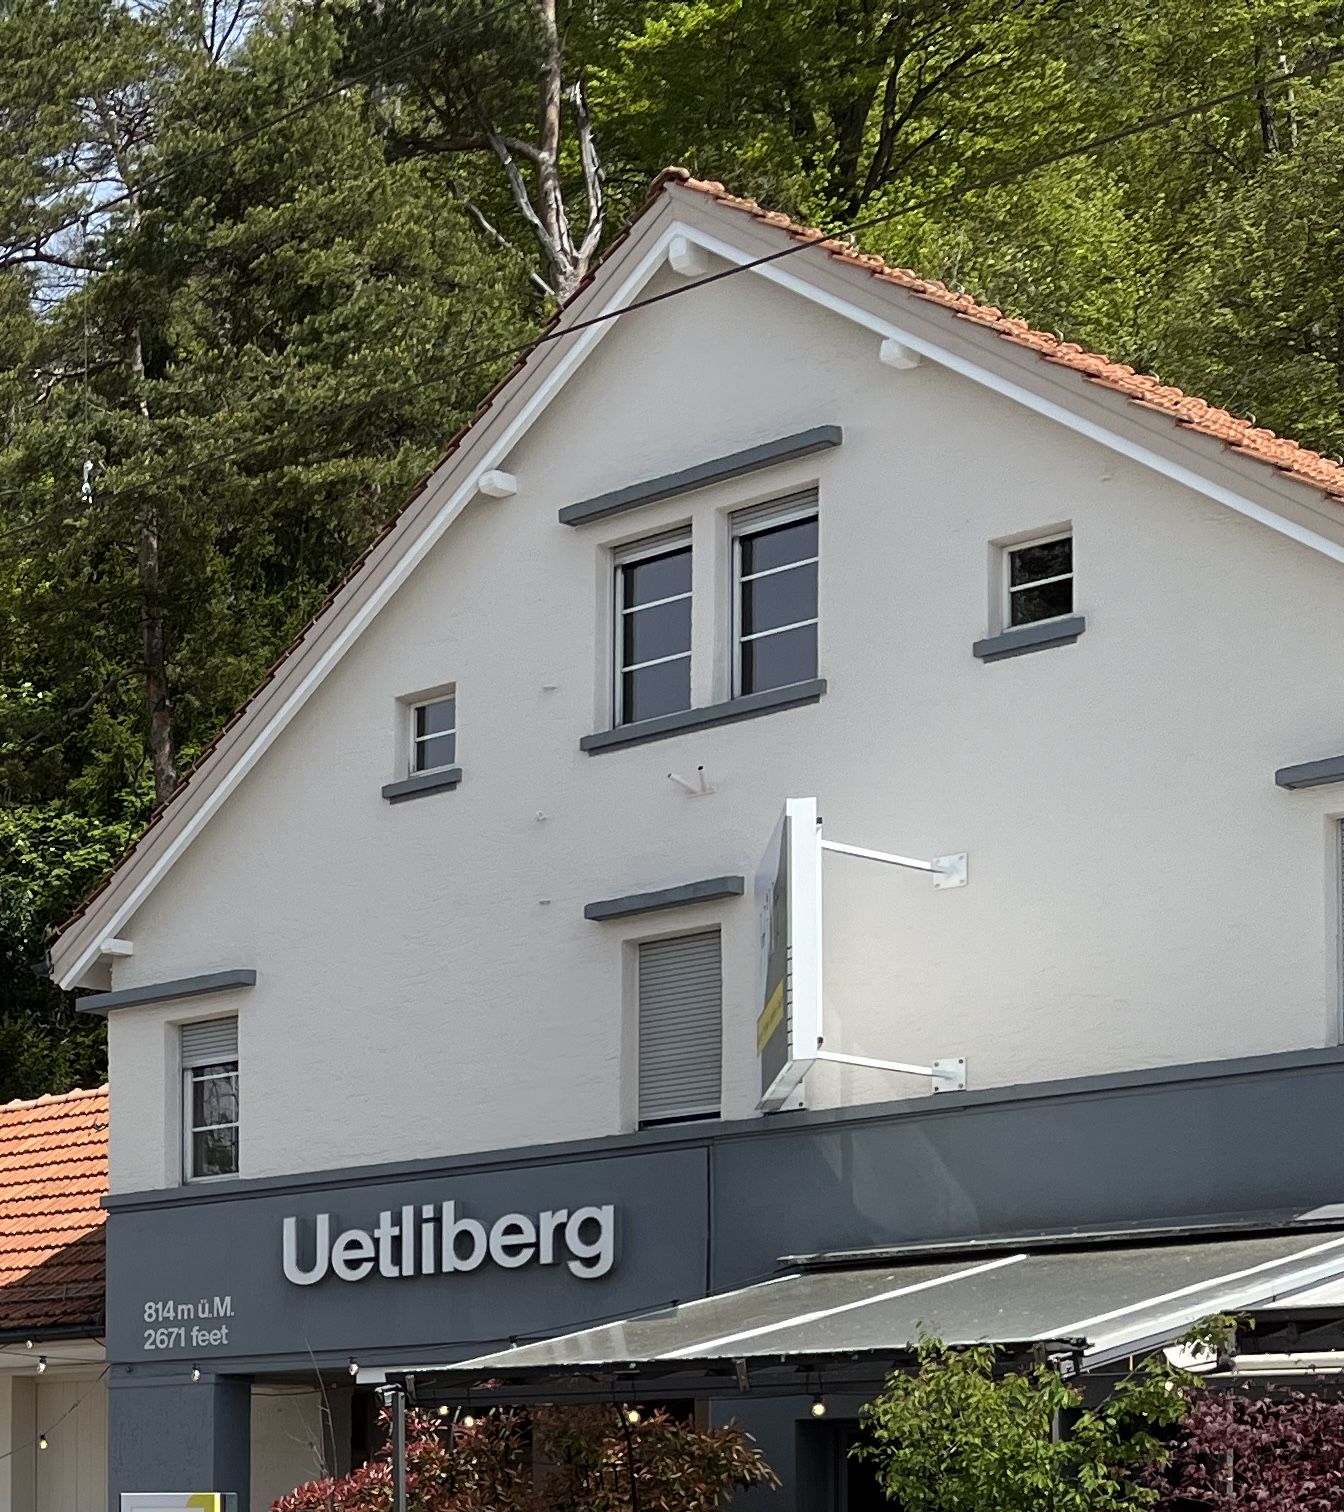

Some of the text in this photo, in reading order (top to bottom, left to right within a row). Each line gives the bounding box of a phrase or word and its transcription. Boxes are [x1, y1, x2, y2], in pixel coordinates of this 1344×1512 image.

[282, 1200, 615, 1286] Uetliberg
[143, 1295, 235, 1323] 814 m ü.M.
[143, 1324, 229, 1350] 2671 feet
